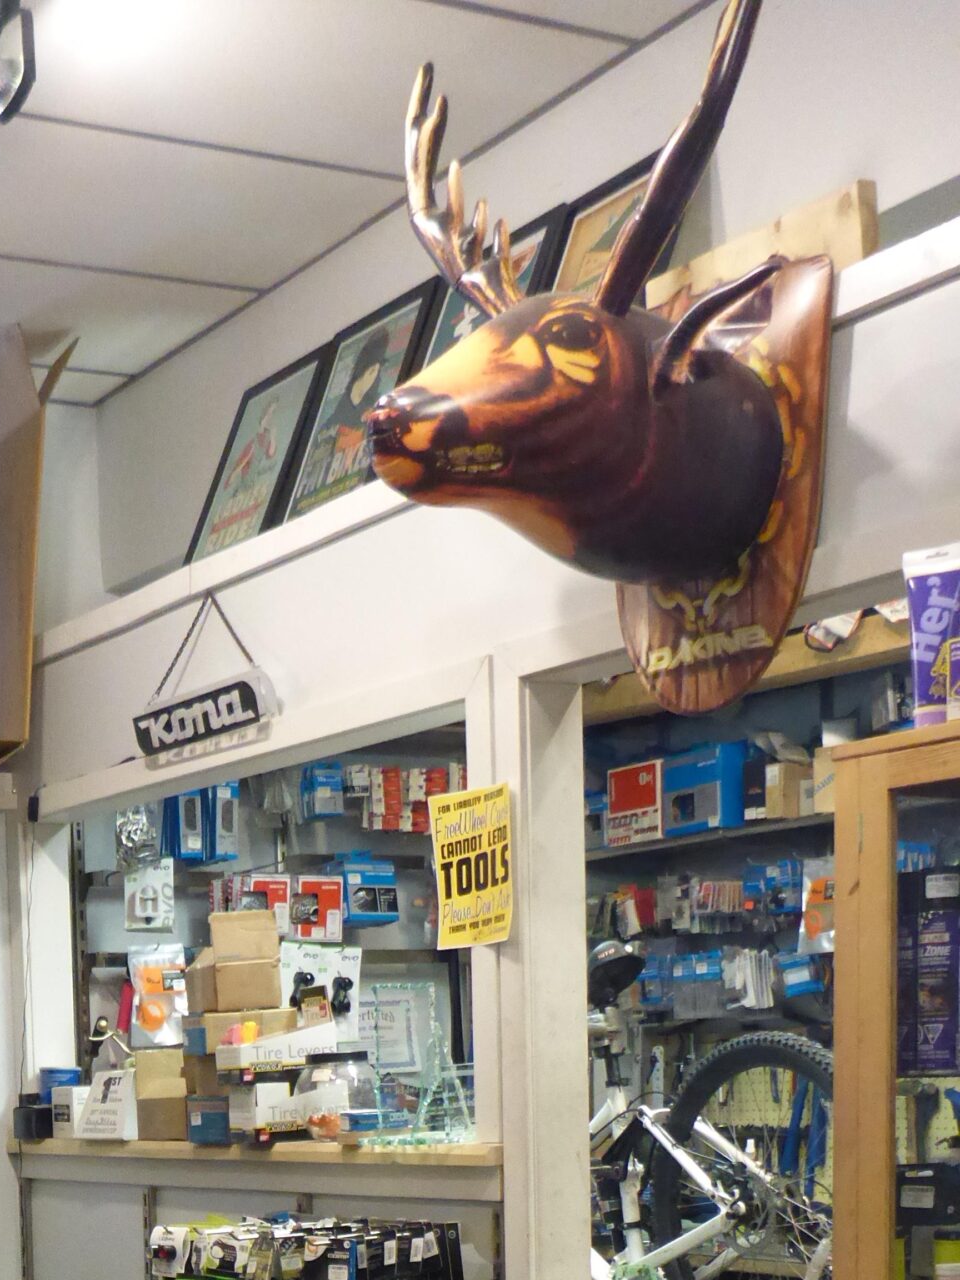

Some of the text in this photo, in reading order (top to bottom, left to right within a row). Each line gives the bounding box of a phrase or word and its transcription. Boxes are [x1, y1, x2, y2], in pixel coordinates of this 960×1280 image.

[646, 624, 774, 673] DAKINE
[438, 805, 451, 815] FOR
[441, 825, 507, 860] CANNOT LEND
[441, 843, 509, 900] TOOLS
[303, 952, 319, 960] evo
[253, 1045, 336, 1060] Tire Levers
[268, 1105, 298, 1120] Tire
